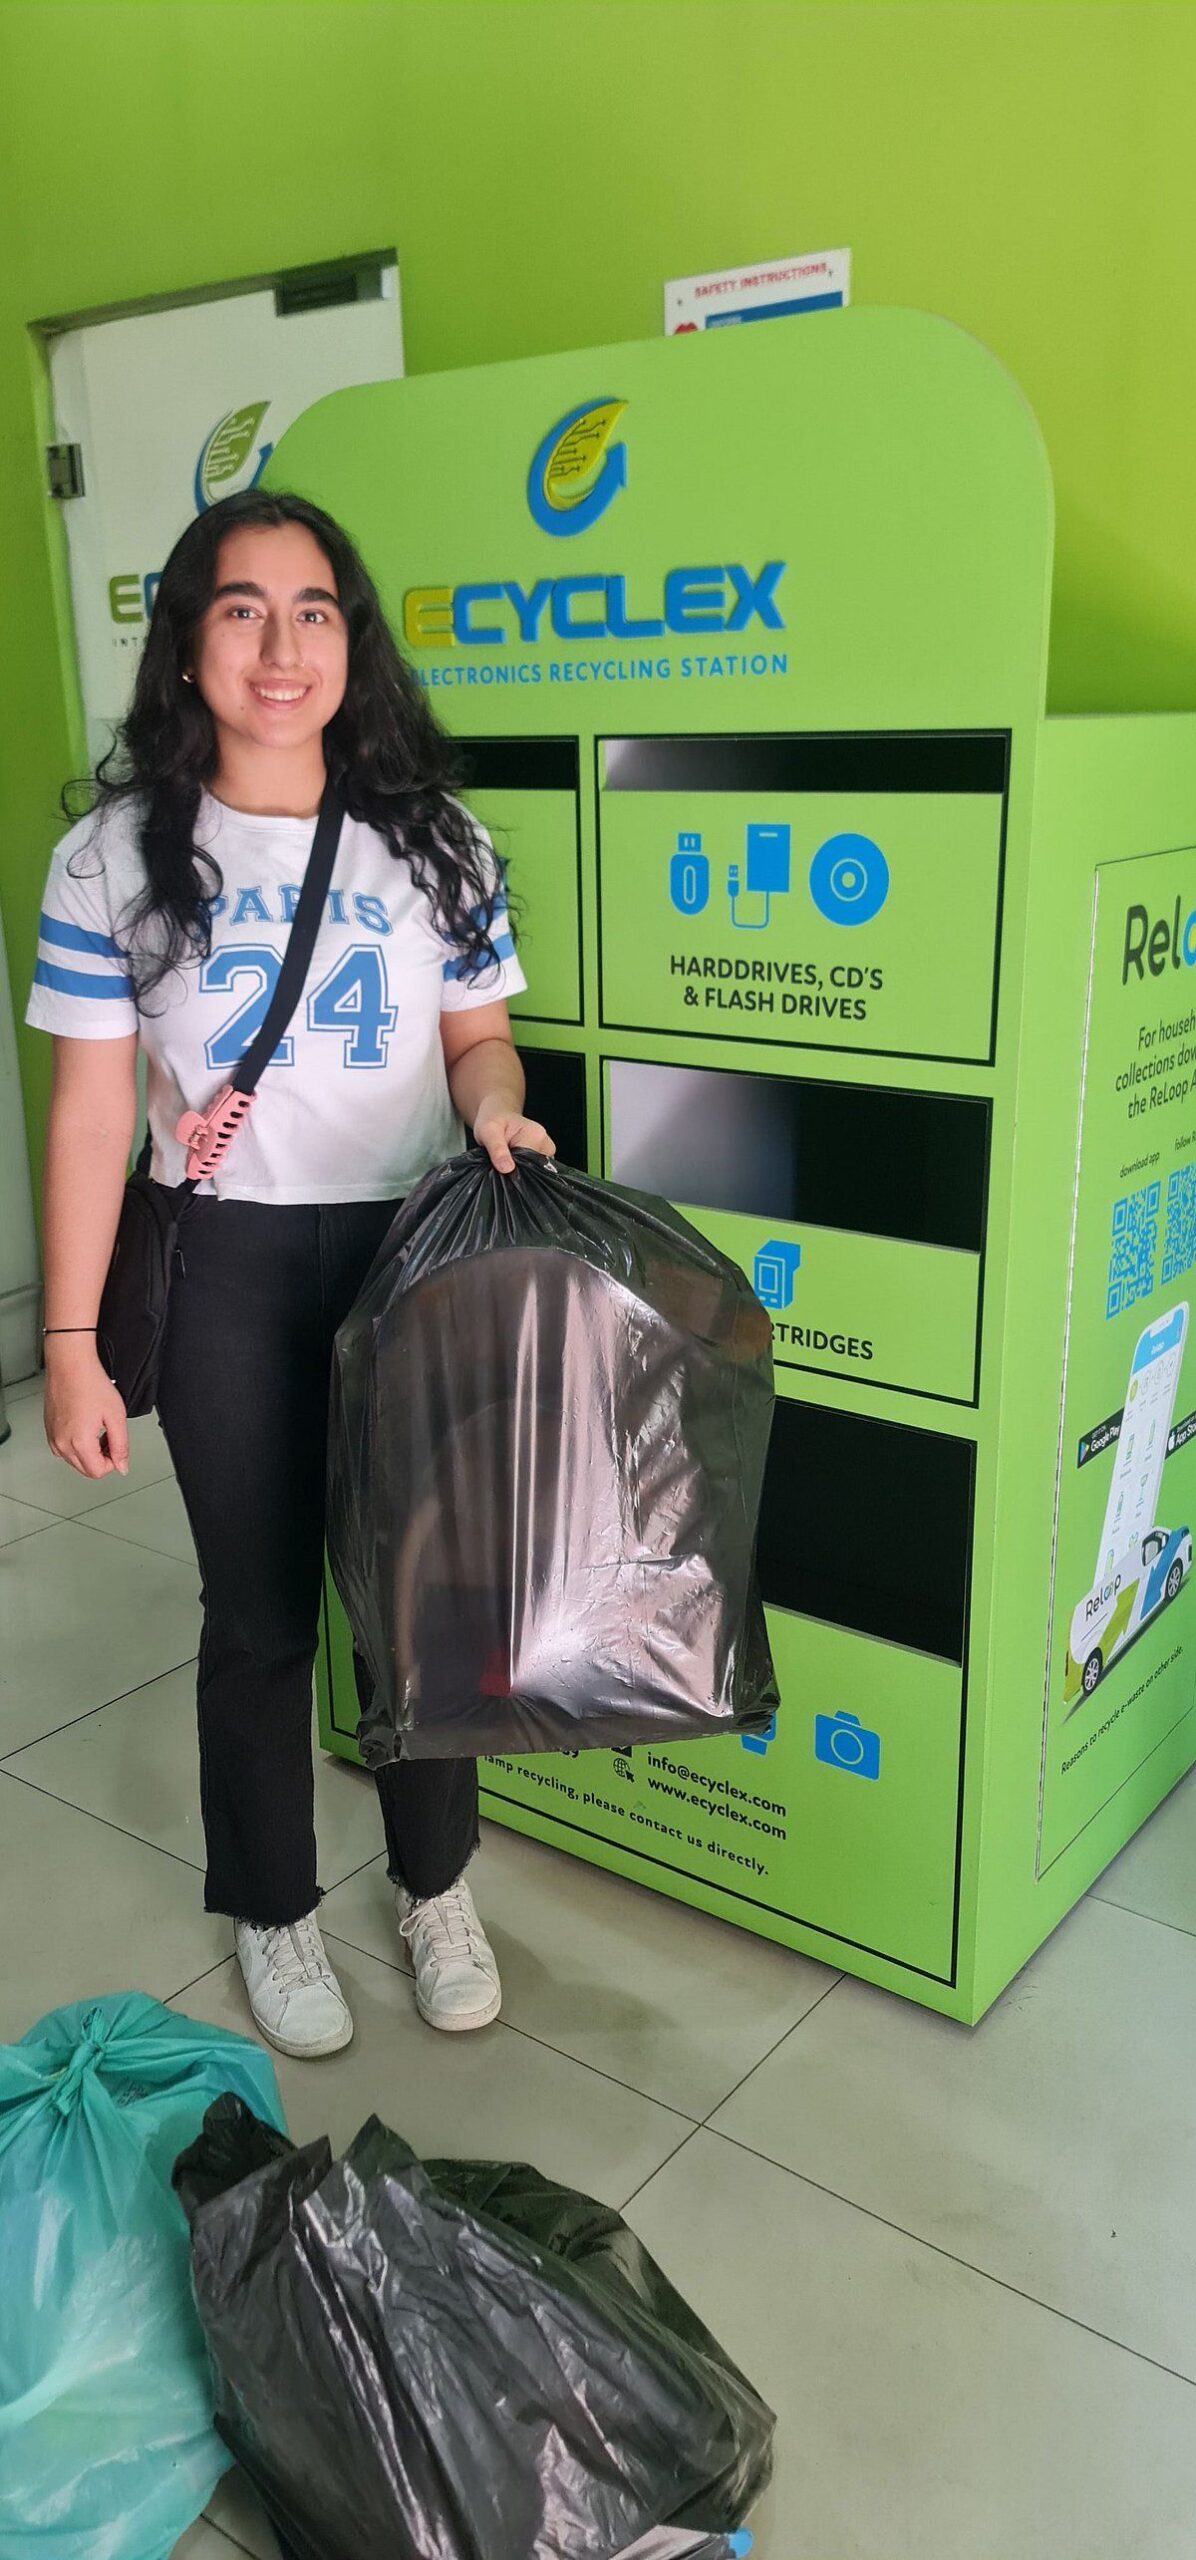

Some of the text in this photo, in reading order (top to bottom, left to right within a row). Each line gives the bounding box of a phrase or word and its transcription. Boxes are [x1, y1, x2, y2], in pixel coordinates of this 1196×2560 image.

[694, 262, 827, 299] SAFETY INSTRUCTIONS
[403, 560, 786, 647] ECYCLEX
[549, 657, 671, 682] RECYCLING
[681, 653, 788, 677] STATION
[670, 954, 883, 991] HARDDRIVES, CD'S
[198, 943, 399, 1070] 24
[683, 986, 867, 1021] & FLASH DRIVES
[1137, 1025, 1157, 1051] For
[1115, 1055, 1175, 1092] collections
[1127, 1092, 1147, 1119] the
[1149, 1081, 1188, 1110] ReLoop
[1120, 1152, 1148, 1178] download
[1090, 1431, 1110, 1452] Google
[1061, 1742, 1088, 1775] Reasons
[1089, 1733, 1097, 1746] to
[1098, 1709, 1120, 1737] recycle
[1121, 1684, 1145, 1713] e-waste
[1146, 1675, 1153, 1688] on
[1154, 1658, 1169, 1679] other
[647, 1751, 787, 1817] info@ecyclex.com
[517, 1766, 579, 1800] recycling,
[583, 1792, 625, 1817] please
[629, 1811, 683, 1840] contact
[687, 1834, 702, 1848] us
[707, 1841, 769, 1876] directly.
[647, 1777, 787, 1841] www.ecyclex.com
